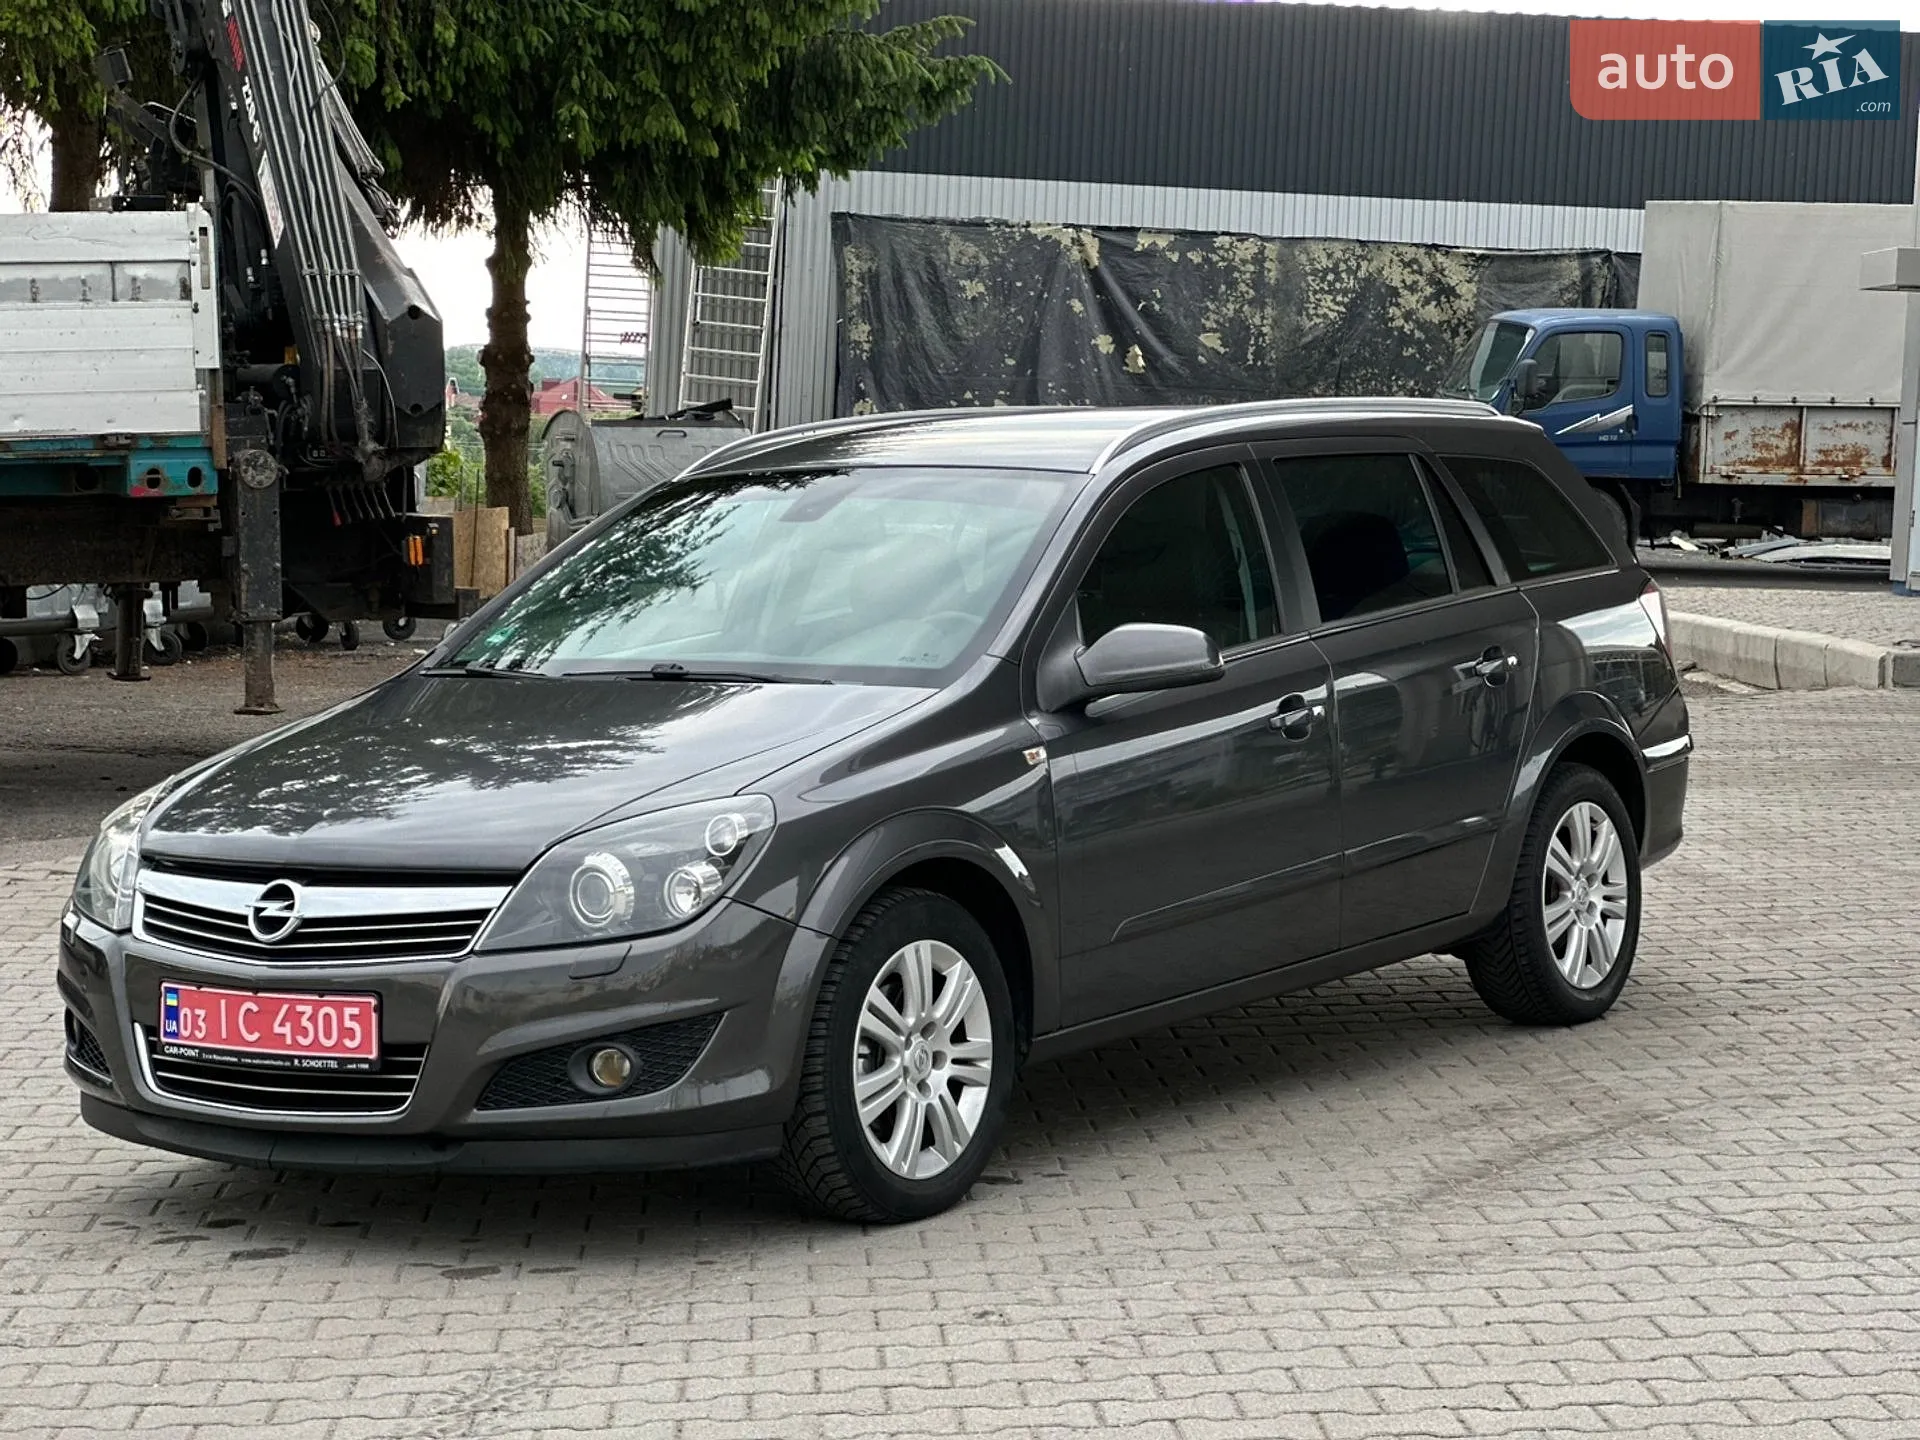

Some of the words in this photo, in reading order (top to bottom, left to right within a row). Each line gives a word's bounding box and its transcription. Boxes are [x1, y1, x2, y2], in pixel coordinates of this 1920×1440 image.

[165, 1019, 178, 1033] UA
[180, 1007, 207, 1040] 03
[219, 998, 261, 1043] IC
[273, 1002, 362, 1051] 4305
[164, 1045, 200, 1059] CAR-POINT
